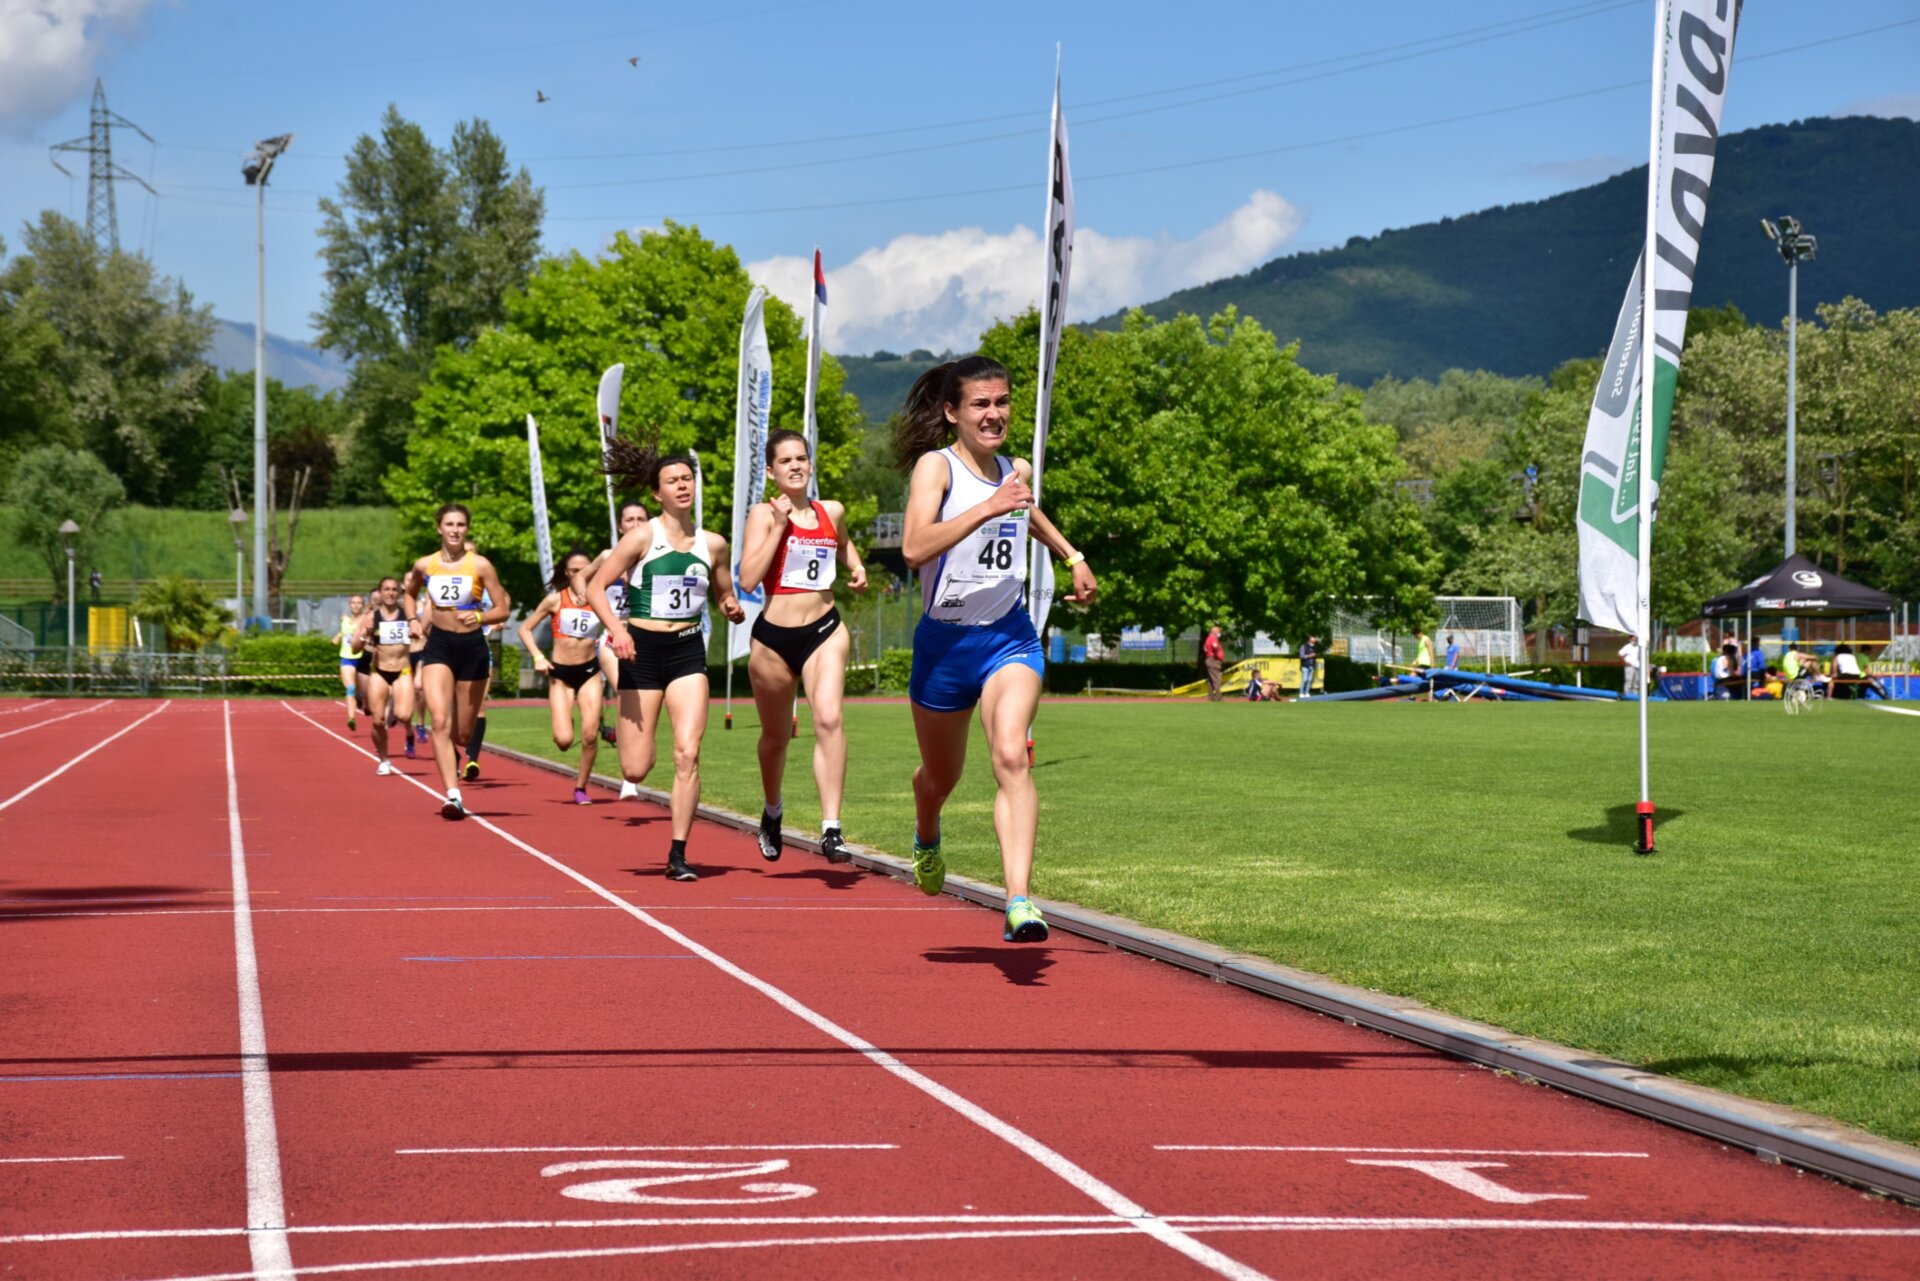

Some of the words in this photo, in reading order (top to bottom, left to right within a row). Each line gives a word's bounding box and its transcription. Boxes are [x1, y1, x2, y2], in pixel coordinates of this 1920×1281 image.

[978, 539, 1012, 570] 48
[807, 559, 819, 581] 8
[440, 585, 460, 600] 23
[669, 588, 691, 610] 31
[389, 628, 404, 640] 55
[571, 617, 589, 632] 16
[539, 1158, 818, 1205] 2
